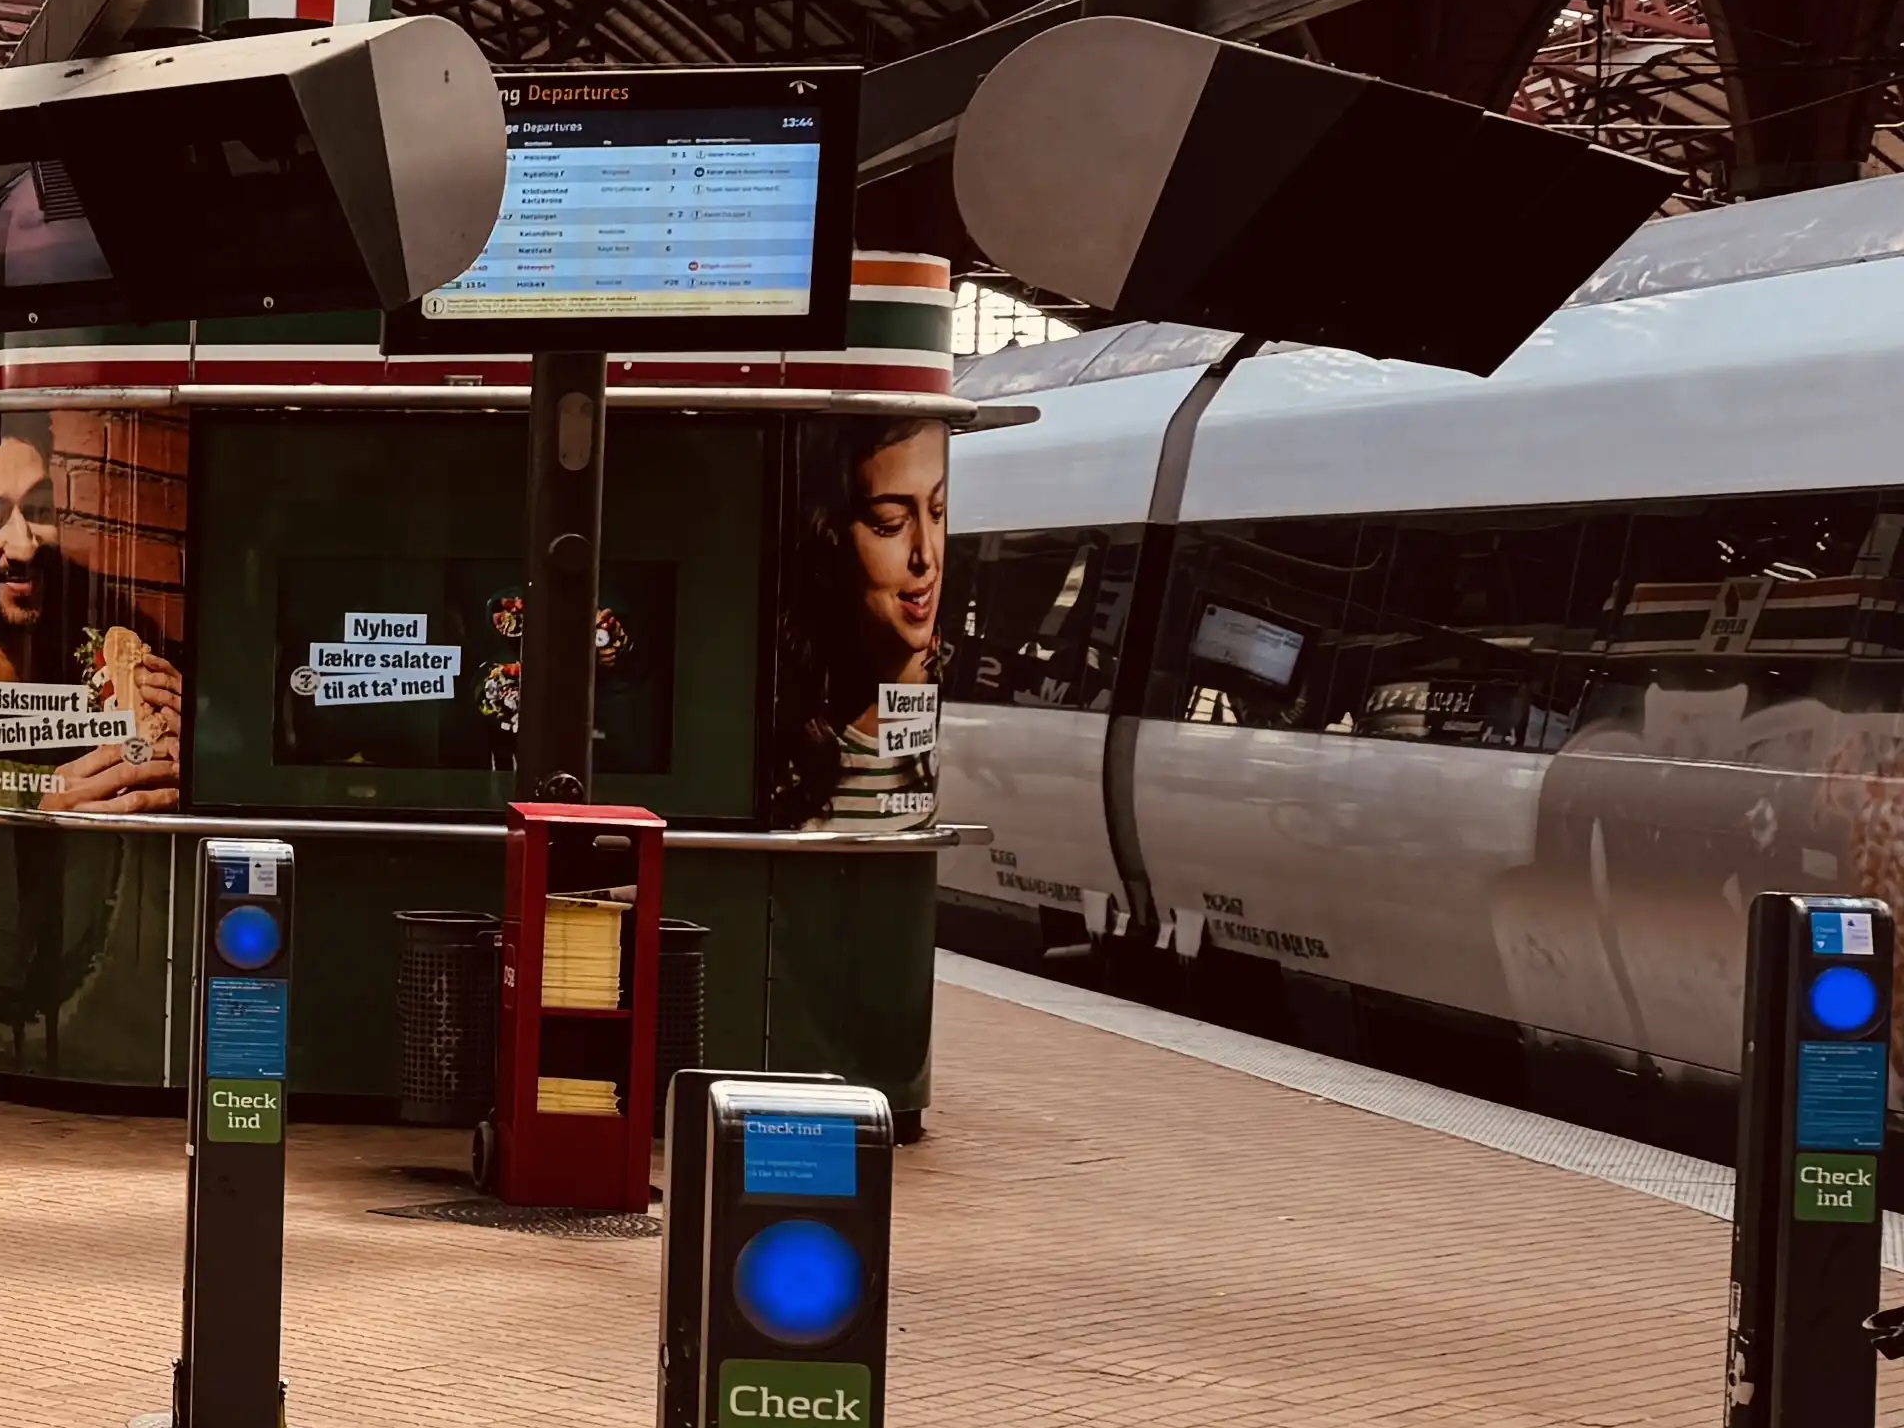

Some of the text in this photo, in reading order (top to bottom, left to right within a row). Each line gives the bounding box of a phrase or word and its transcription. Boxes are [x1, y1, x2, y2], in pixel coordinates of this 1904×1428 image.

[528, 84, 630, 105] Departures
[523, 122, 583, 134] Departures
[353, 618, 418, 641] Nyhed
[318, 648, 453, 670] lækre salater
[323, 680, 344, 699] til
[347, 680, 368, 699] at
[401, 675, 445, 695] med
[886, 690, 925, 713] Værd
[29, 717, 53, 747] på
[56, 717, 128, 742] farten
[909, 722, 933, 749] med
[212, 1090, 277, 1110] Check
[226, 1112, 261, 1130] ind
[745, 1120, 823, 1136] Check ind
[1799, 1165, 1873, 1188] Check
[1816, 1188, 1853, 1208] ind
[729, 1384, 861, 1422] Check
